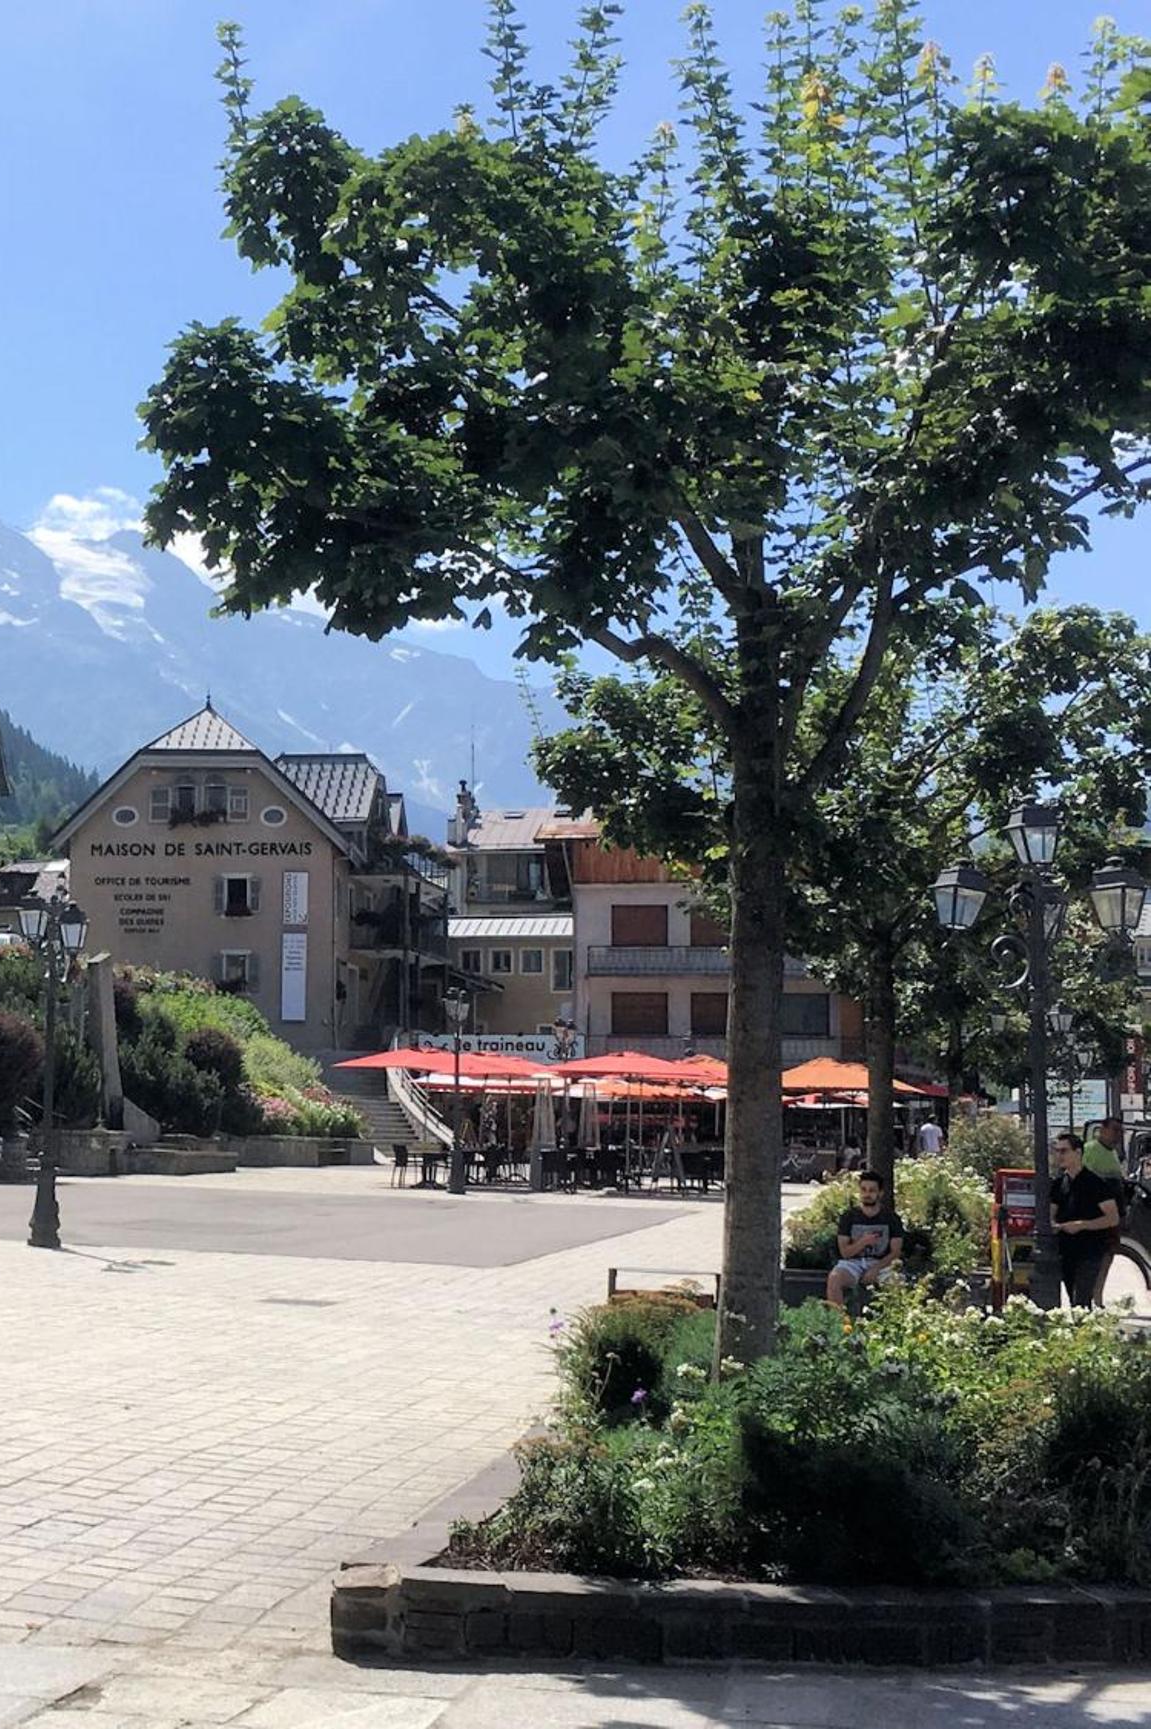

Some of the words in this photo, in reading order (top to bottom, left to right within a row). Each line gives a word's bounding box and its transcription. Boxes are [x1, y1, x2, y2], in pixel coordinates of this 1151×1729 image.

[90, 843, 156, 857] MAISON
[164, 843, 185, 857] DE
[195, 842, 313, 856] SAINT-GERVAIS
[94, 877, 125, 886] OFFICE
[128, 877, 141, 886] DE
[145, 877, 191, 886] TOURISME
[477, 1037, 546, 1052] traineau
